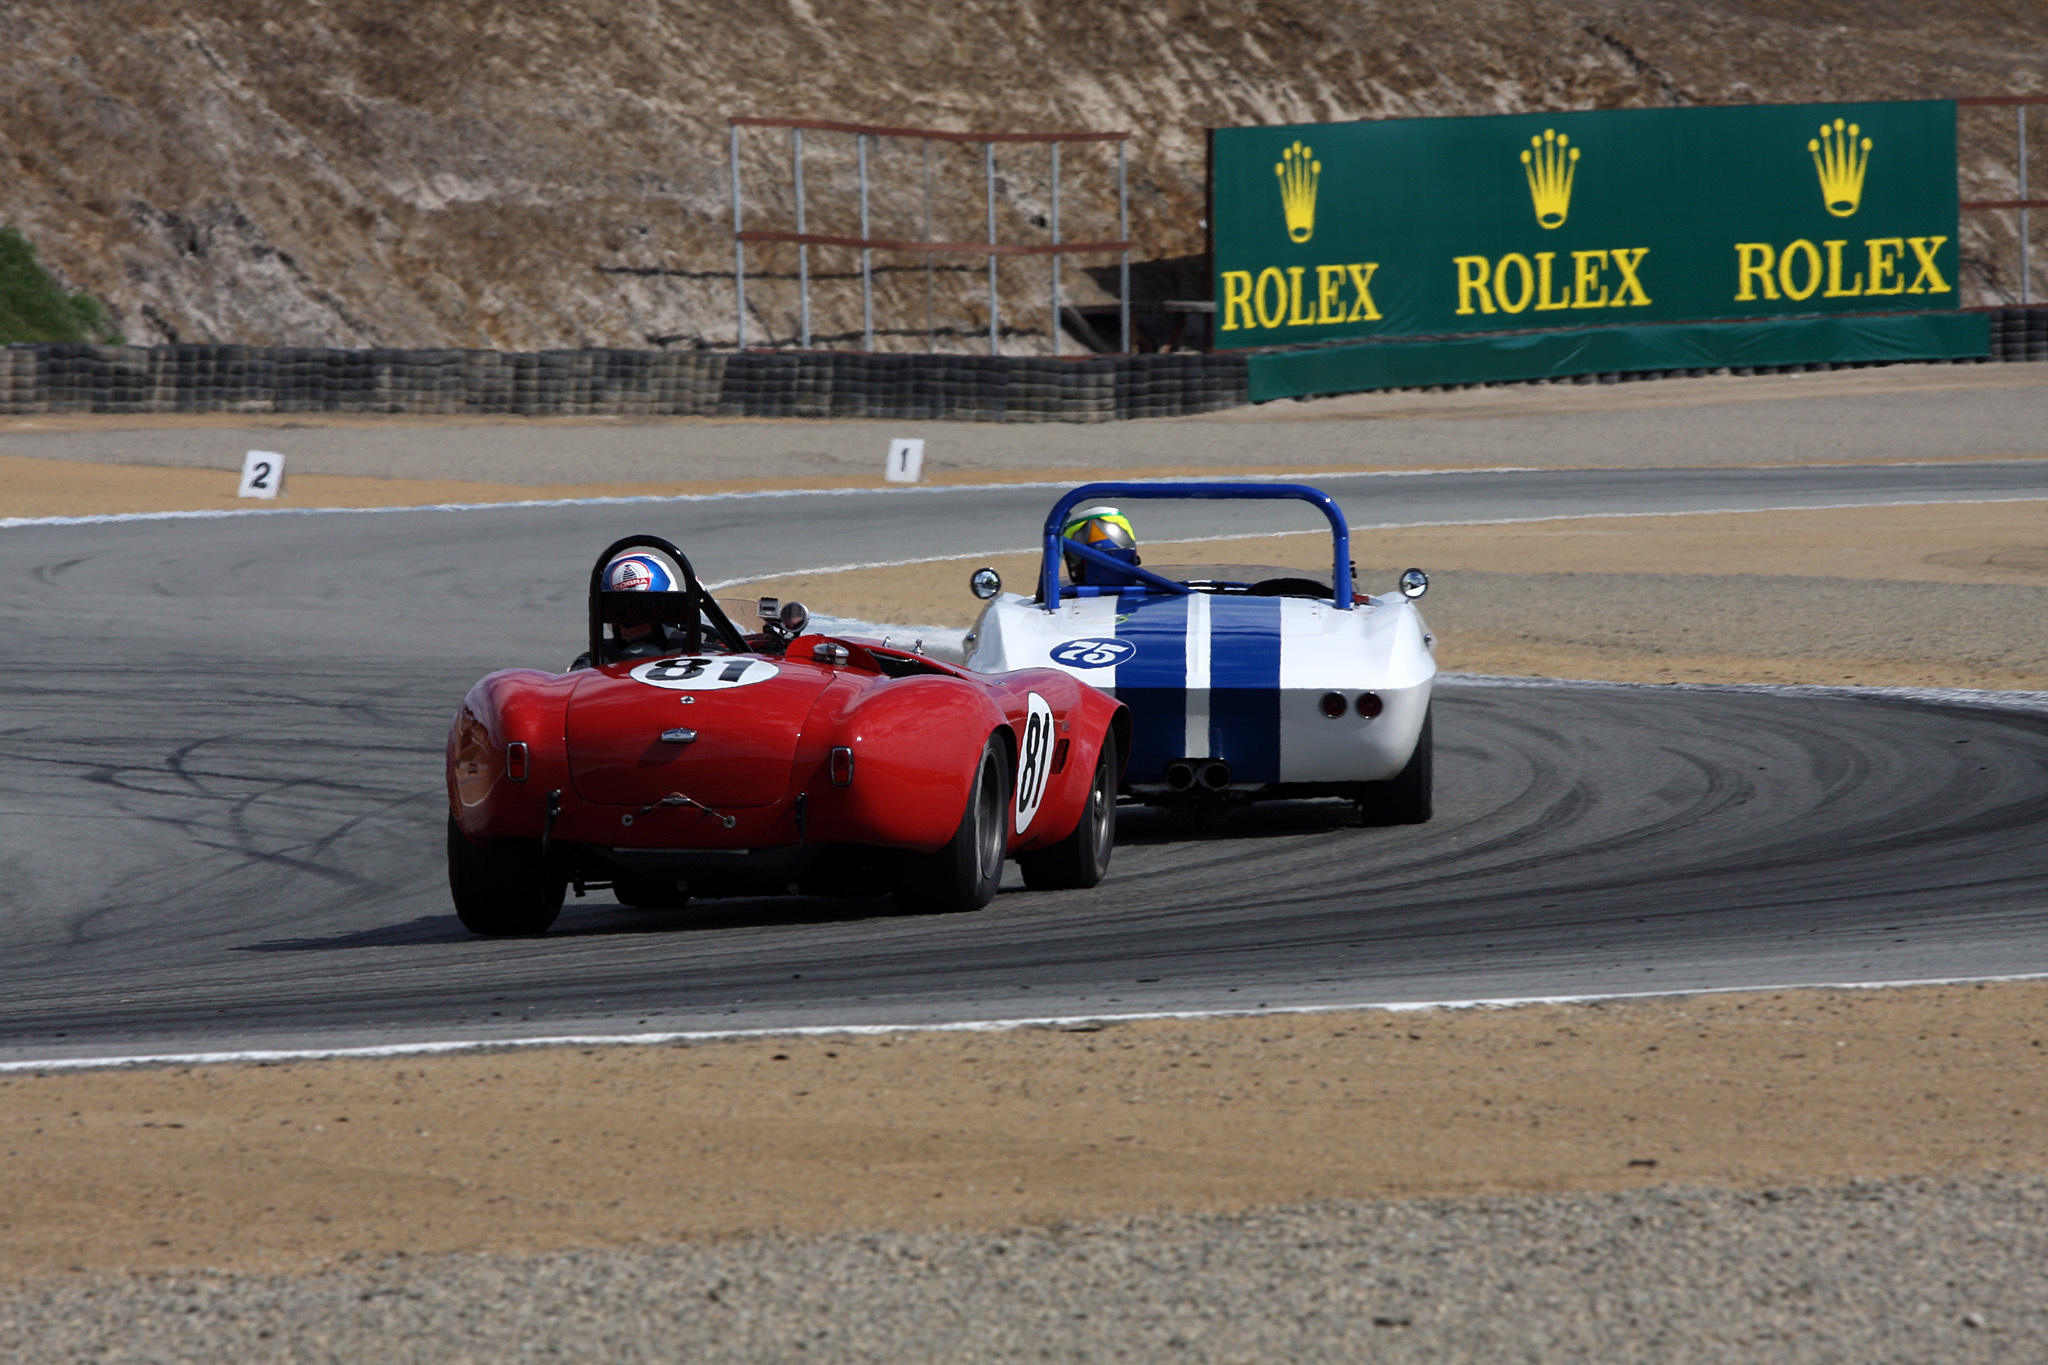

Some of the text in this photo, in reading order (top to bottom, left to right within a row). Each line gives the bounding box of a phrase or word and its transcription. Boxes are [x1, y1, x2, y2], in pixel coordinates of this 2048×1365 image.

[1453, 247, 1652, 315] ROLEX
[1734, 235, 1952, 302] ROLEX
[1221, 261, 1383, 331] ROLEX
[901, 447, 909, 473] 1
[251, 462, 271, 489] 2
[614, 579, 648, 590] COBRA
[1058, 641, 1130, 664] 75
[645, 658, 754, 682] 81
[1018, 712, 1050, 813] 81
